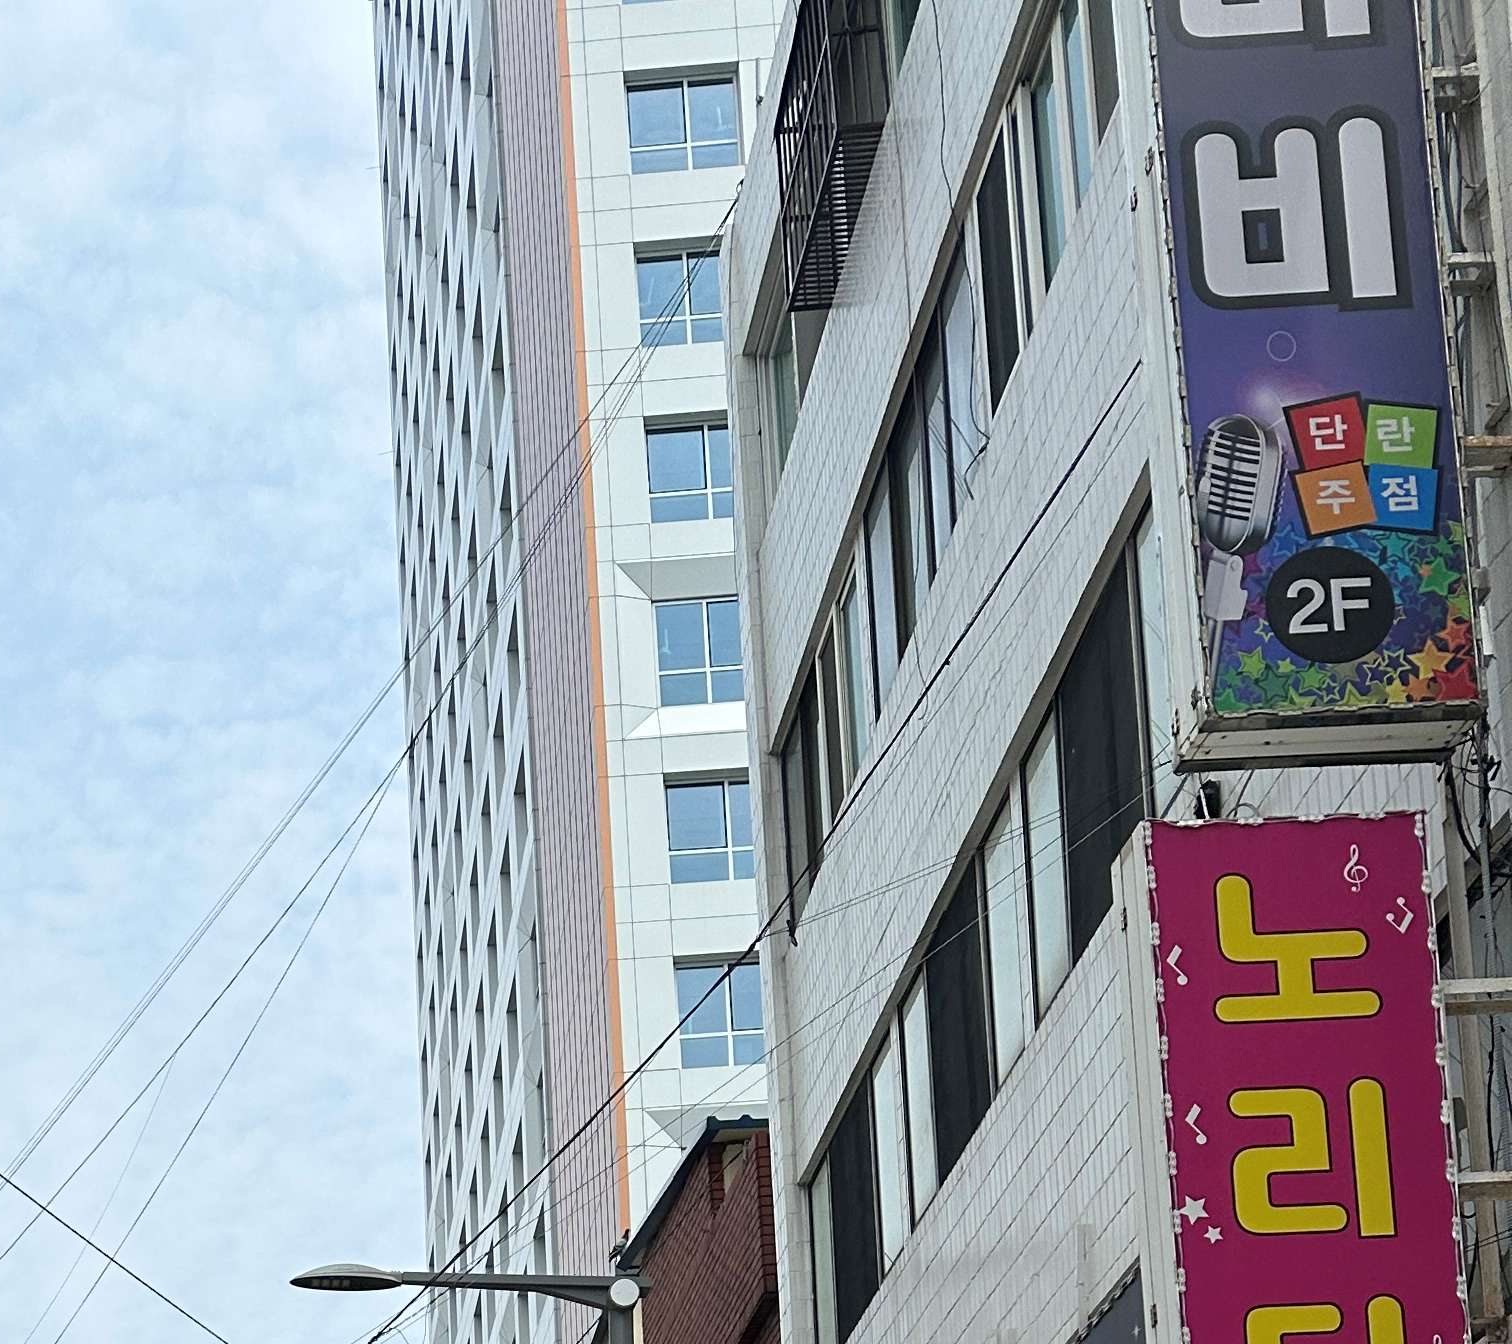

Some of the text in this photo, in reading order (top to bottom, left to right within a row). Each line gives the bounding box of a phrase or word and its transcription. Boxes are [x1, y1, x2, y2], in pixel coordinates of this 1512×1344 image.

[1307, 412, 1416, 454] 단란
[1315, 473, 1419, 516] 주점
[1285, 578, 1372, 636] 2F
